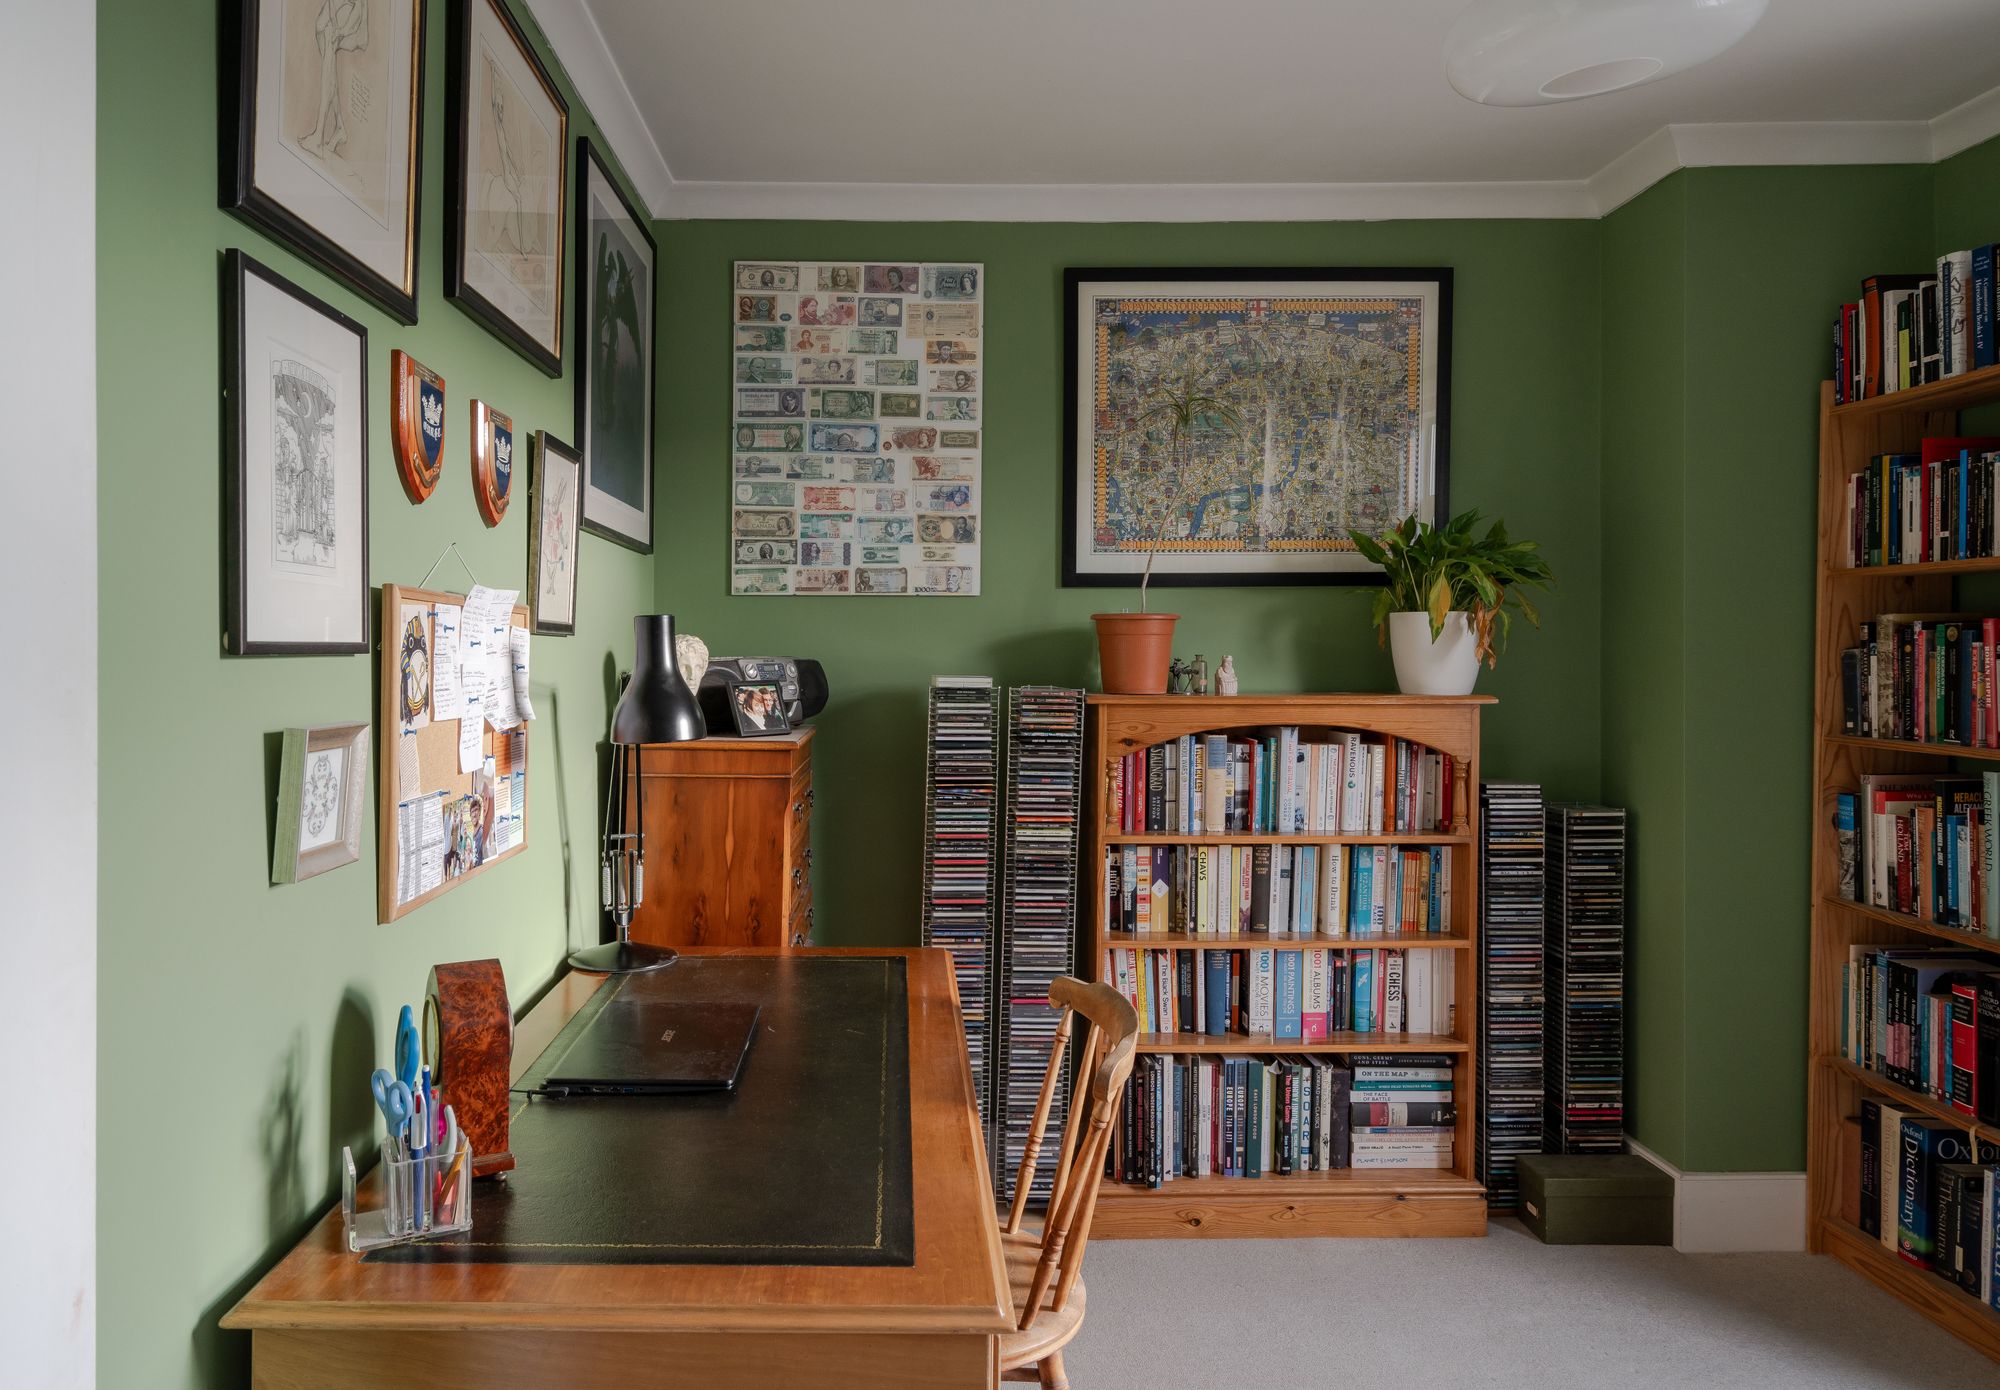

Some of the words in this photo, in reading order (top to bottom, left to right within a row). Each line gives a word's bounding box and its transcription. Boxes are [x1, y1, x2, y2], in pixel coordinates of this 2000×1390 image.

[1097, 447, 1106, 489] LONDON
[1097, 491, 1106, 525] GREAT
[1150, 748, 1165, 792] STALINGRAD
[1195, 747, 1204, 768] WORK
[1349, 736, 1357, 778] RAVENOUS
[1984, 791, 1992, 827] GREEK
[1984, 830, 1992, 872] WORLD
[1331, 876, 1338, 885] to
[1260, 951, 1269, 973] 1001
[1313, 950, 1321, 968] 1001
[1260, 976, 1269, 1016] MOVIES
[1313, 971, 1321, 1009] ALBUMS
[1389, 972, 1400, 1001] CHESS
[1226, 1087, 1234, 1111] EUROPE
[1302, 1087, 1310, 1140] SOAR
[1900, 1124, 1922, 1141] Oxford
[1882, 1171, 1893, 1225] Dictionary
[1896, 1136, 1919, 1227] Dictionary
[1937, 1186, 1952, 1259] Thesaurus
